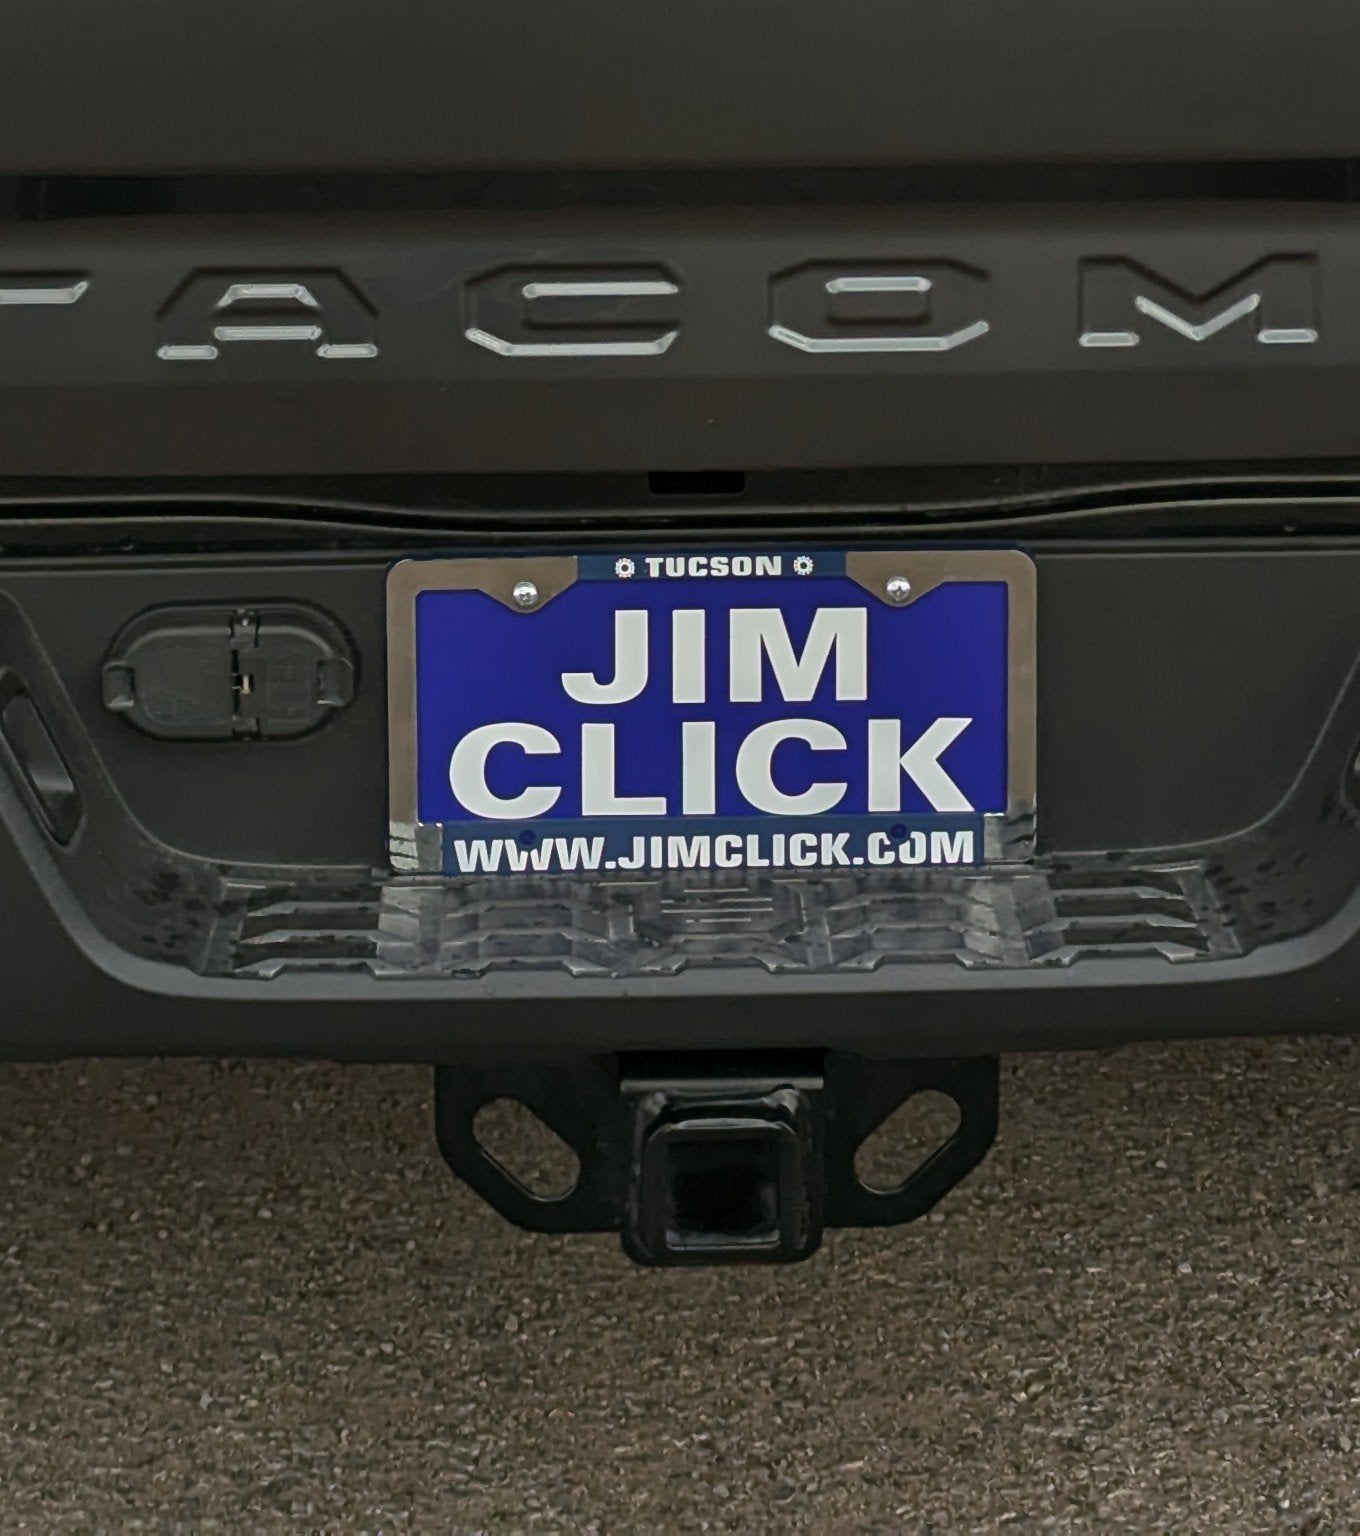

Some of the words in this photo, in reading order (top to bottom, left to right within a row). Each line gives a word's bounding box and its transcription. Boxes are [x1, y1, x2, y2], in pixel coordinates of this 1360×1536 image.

[644, 555, 783, 579] TUCSON
[560, 606, 869, 706] JIM
[448, 717, 976, 820] CLICK
[454, 830, 975, 873] WWW.JIMCLICK.COM
